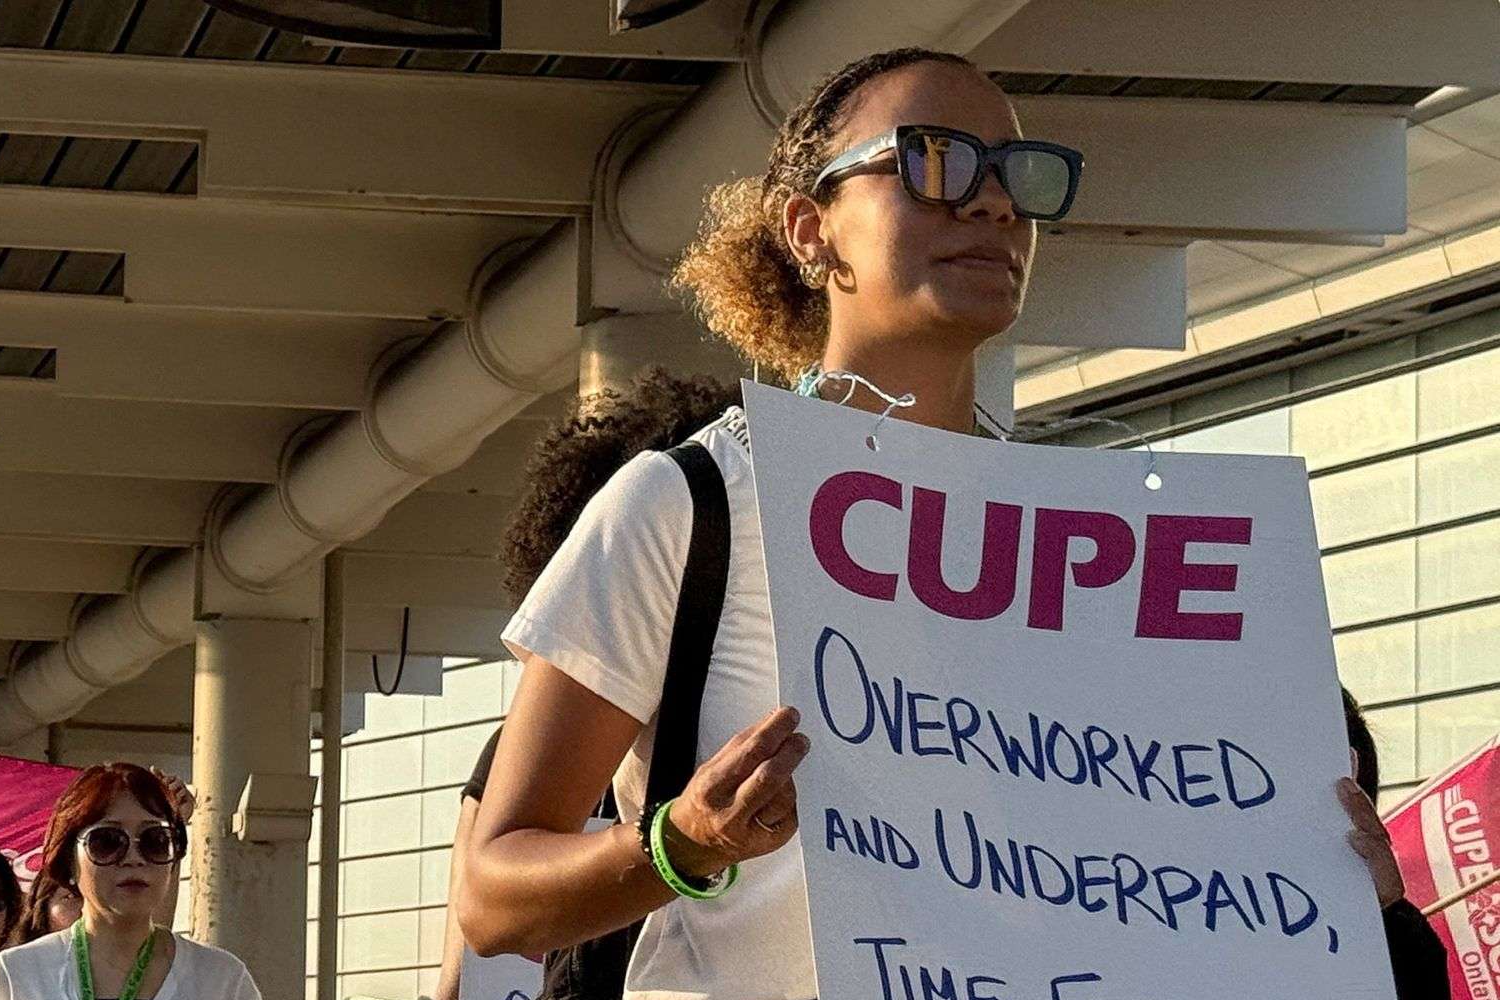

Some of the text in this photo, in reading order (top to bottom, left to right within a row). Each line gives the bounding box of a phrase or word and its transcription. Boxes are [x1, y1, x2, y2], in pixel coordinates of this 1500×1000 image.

[810, 471, 1253, 641] CUPE
[814, 626, 1275, 810] OVERWORKED
[825, 808, 1338, 953] AND UNDERPAID,
[1445, 799, 1494, 889] CUPE
